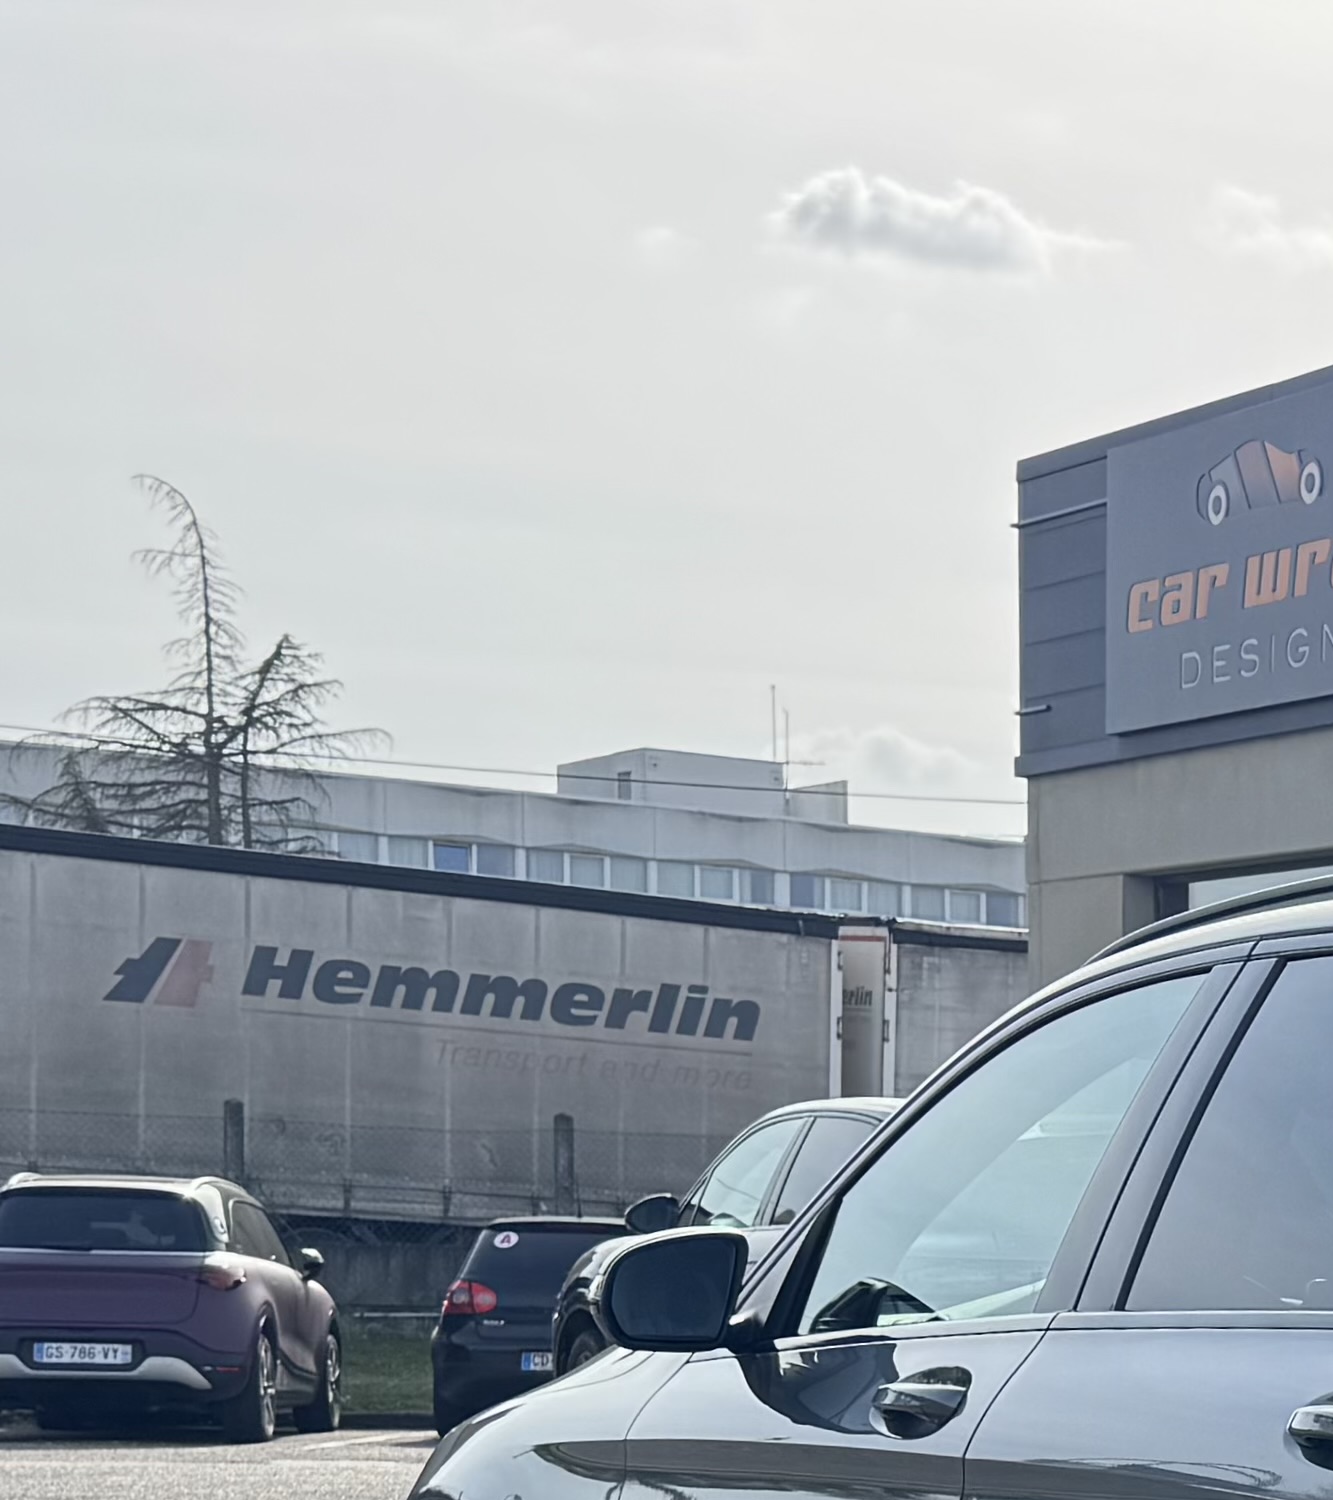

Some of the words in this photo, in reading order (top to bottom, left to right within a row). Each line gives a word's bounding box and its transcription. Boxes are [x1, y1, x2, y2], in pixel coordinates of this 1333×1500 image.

[1126, 562, 1229, 634] car
[241, 944, 761, 1041] Hemmerlin
[436, 1038, 588, 1076] Transport
[602, 1056, 661, 1083] and
[674, 1063, 751, 1090] more
[501, 1234, 512, 1245] A
